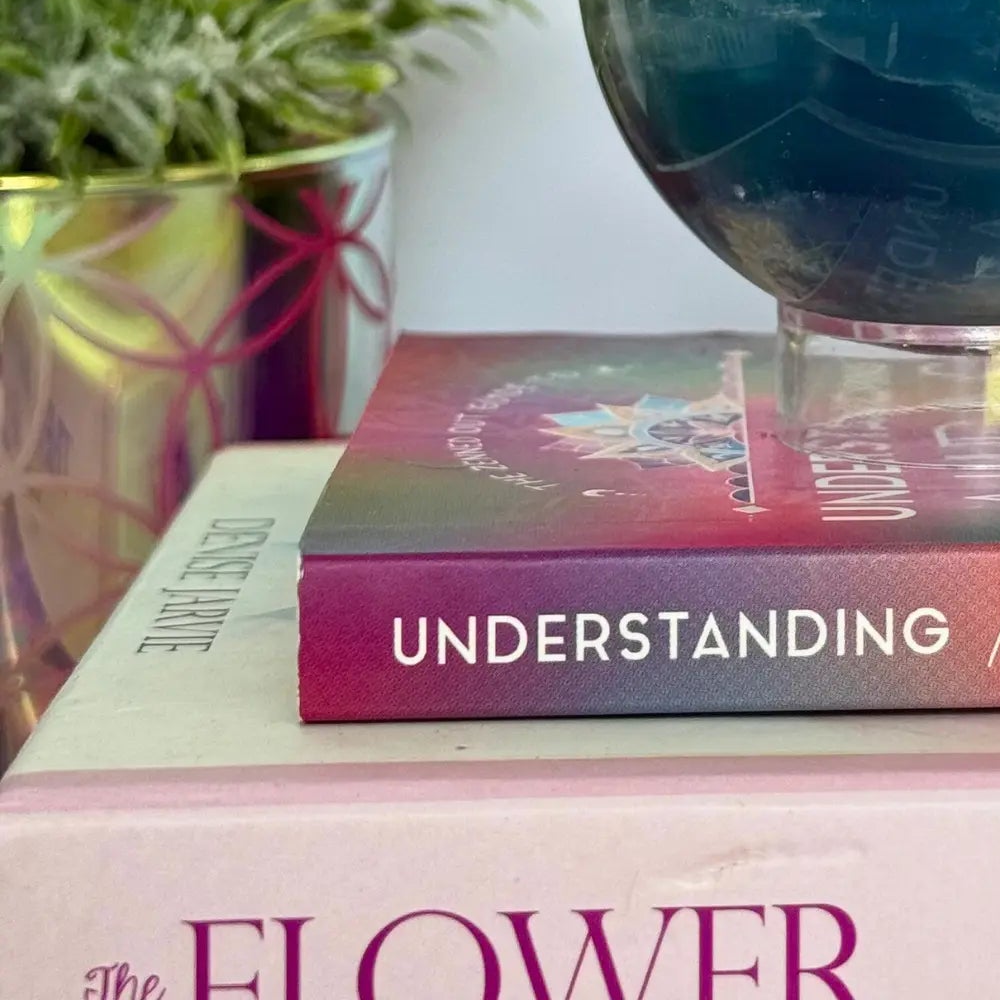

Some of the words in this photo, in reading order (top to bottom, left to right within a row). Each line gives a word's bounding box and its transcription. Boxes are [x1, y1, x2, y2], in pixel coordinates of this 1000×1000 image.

[180, 518, 276, 581] DENISE
[136, 587, 241, 653] JARVIE
[393, 607, 949, 666] UNDERSTANDING
[84, 962, 167, 1000] The
[181, 904, 857, 1000] FLOWER
